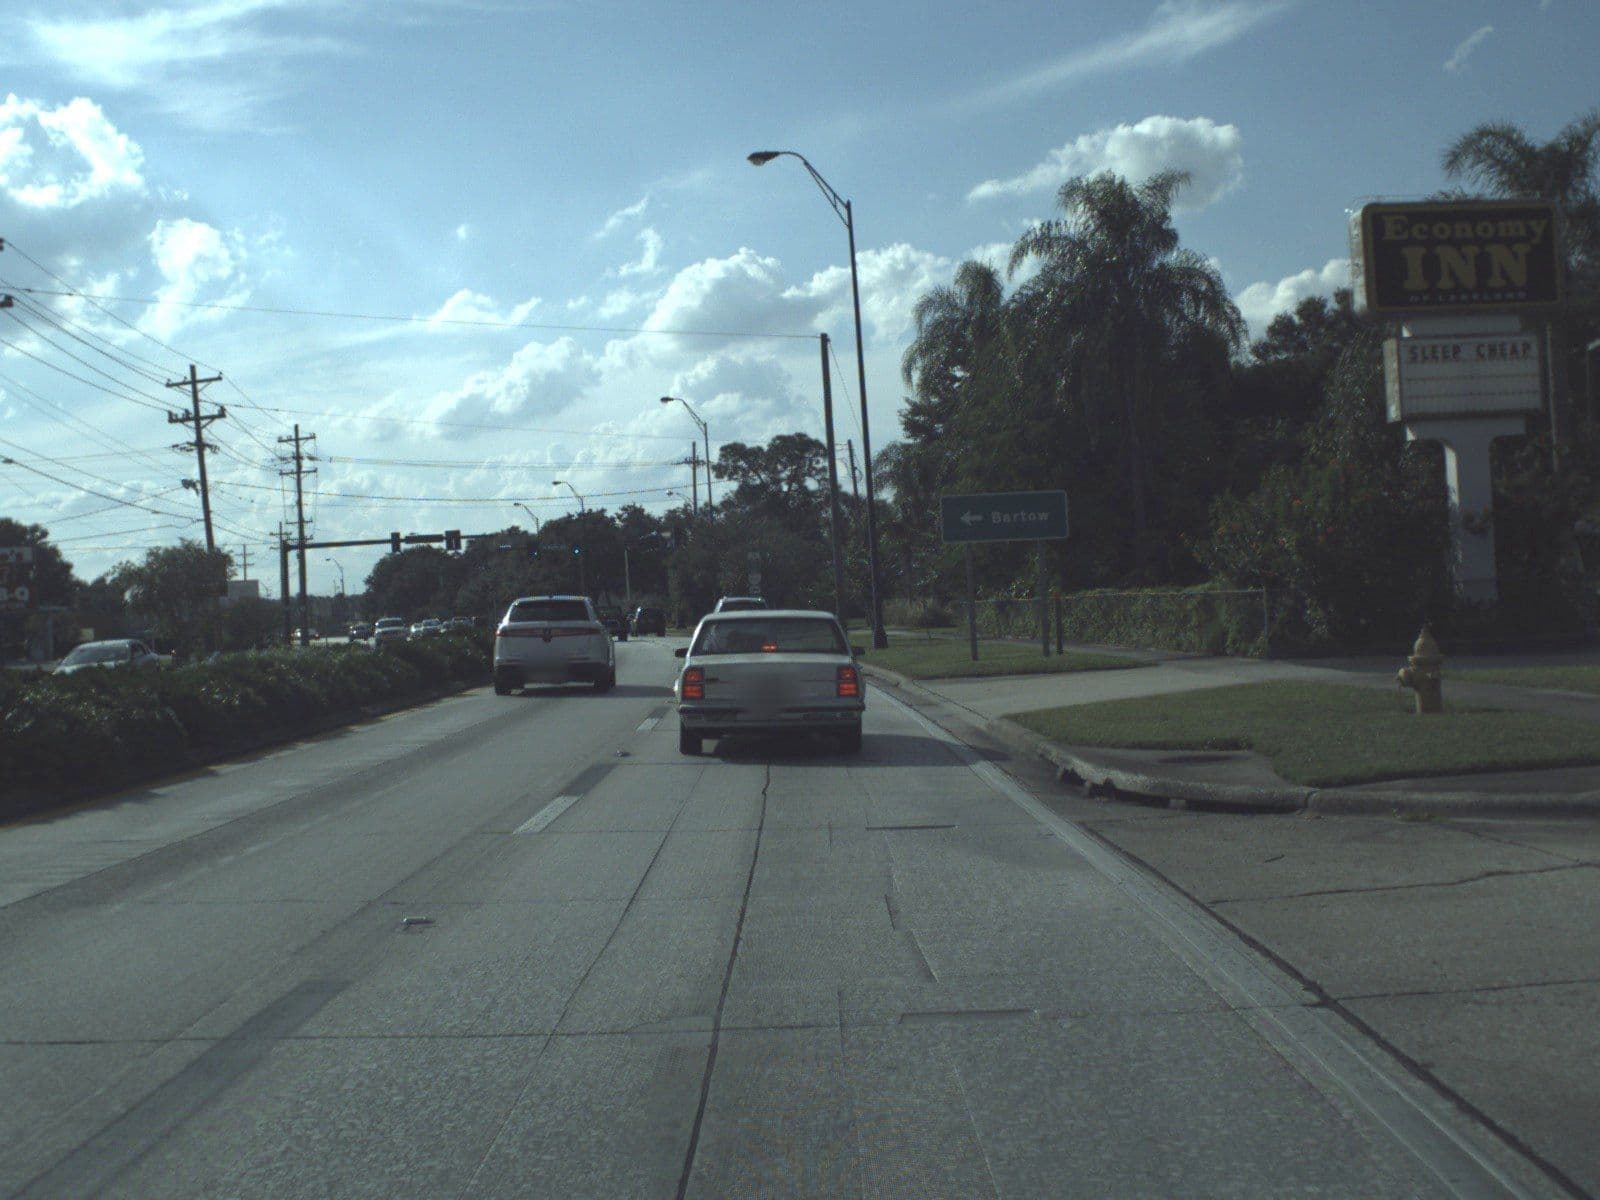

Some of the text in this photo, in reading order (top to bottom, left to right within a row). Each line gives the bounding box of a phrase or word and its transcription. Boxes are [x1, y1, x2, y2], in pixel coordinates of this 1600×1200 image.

[1381, 214, 1548, 245] Economy
[1401, 243, 1532, 291] INN
[1408, 341, 1531, 362] SLEEP CHEAP
[991, 510, 1050, 524] Bartow
